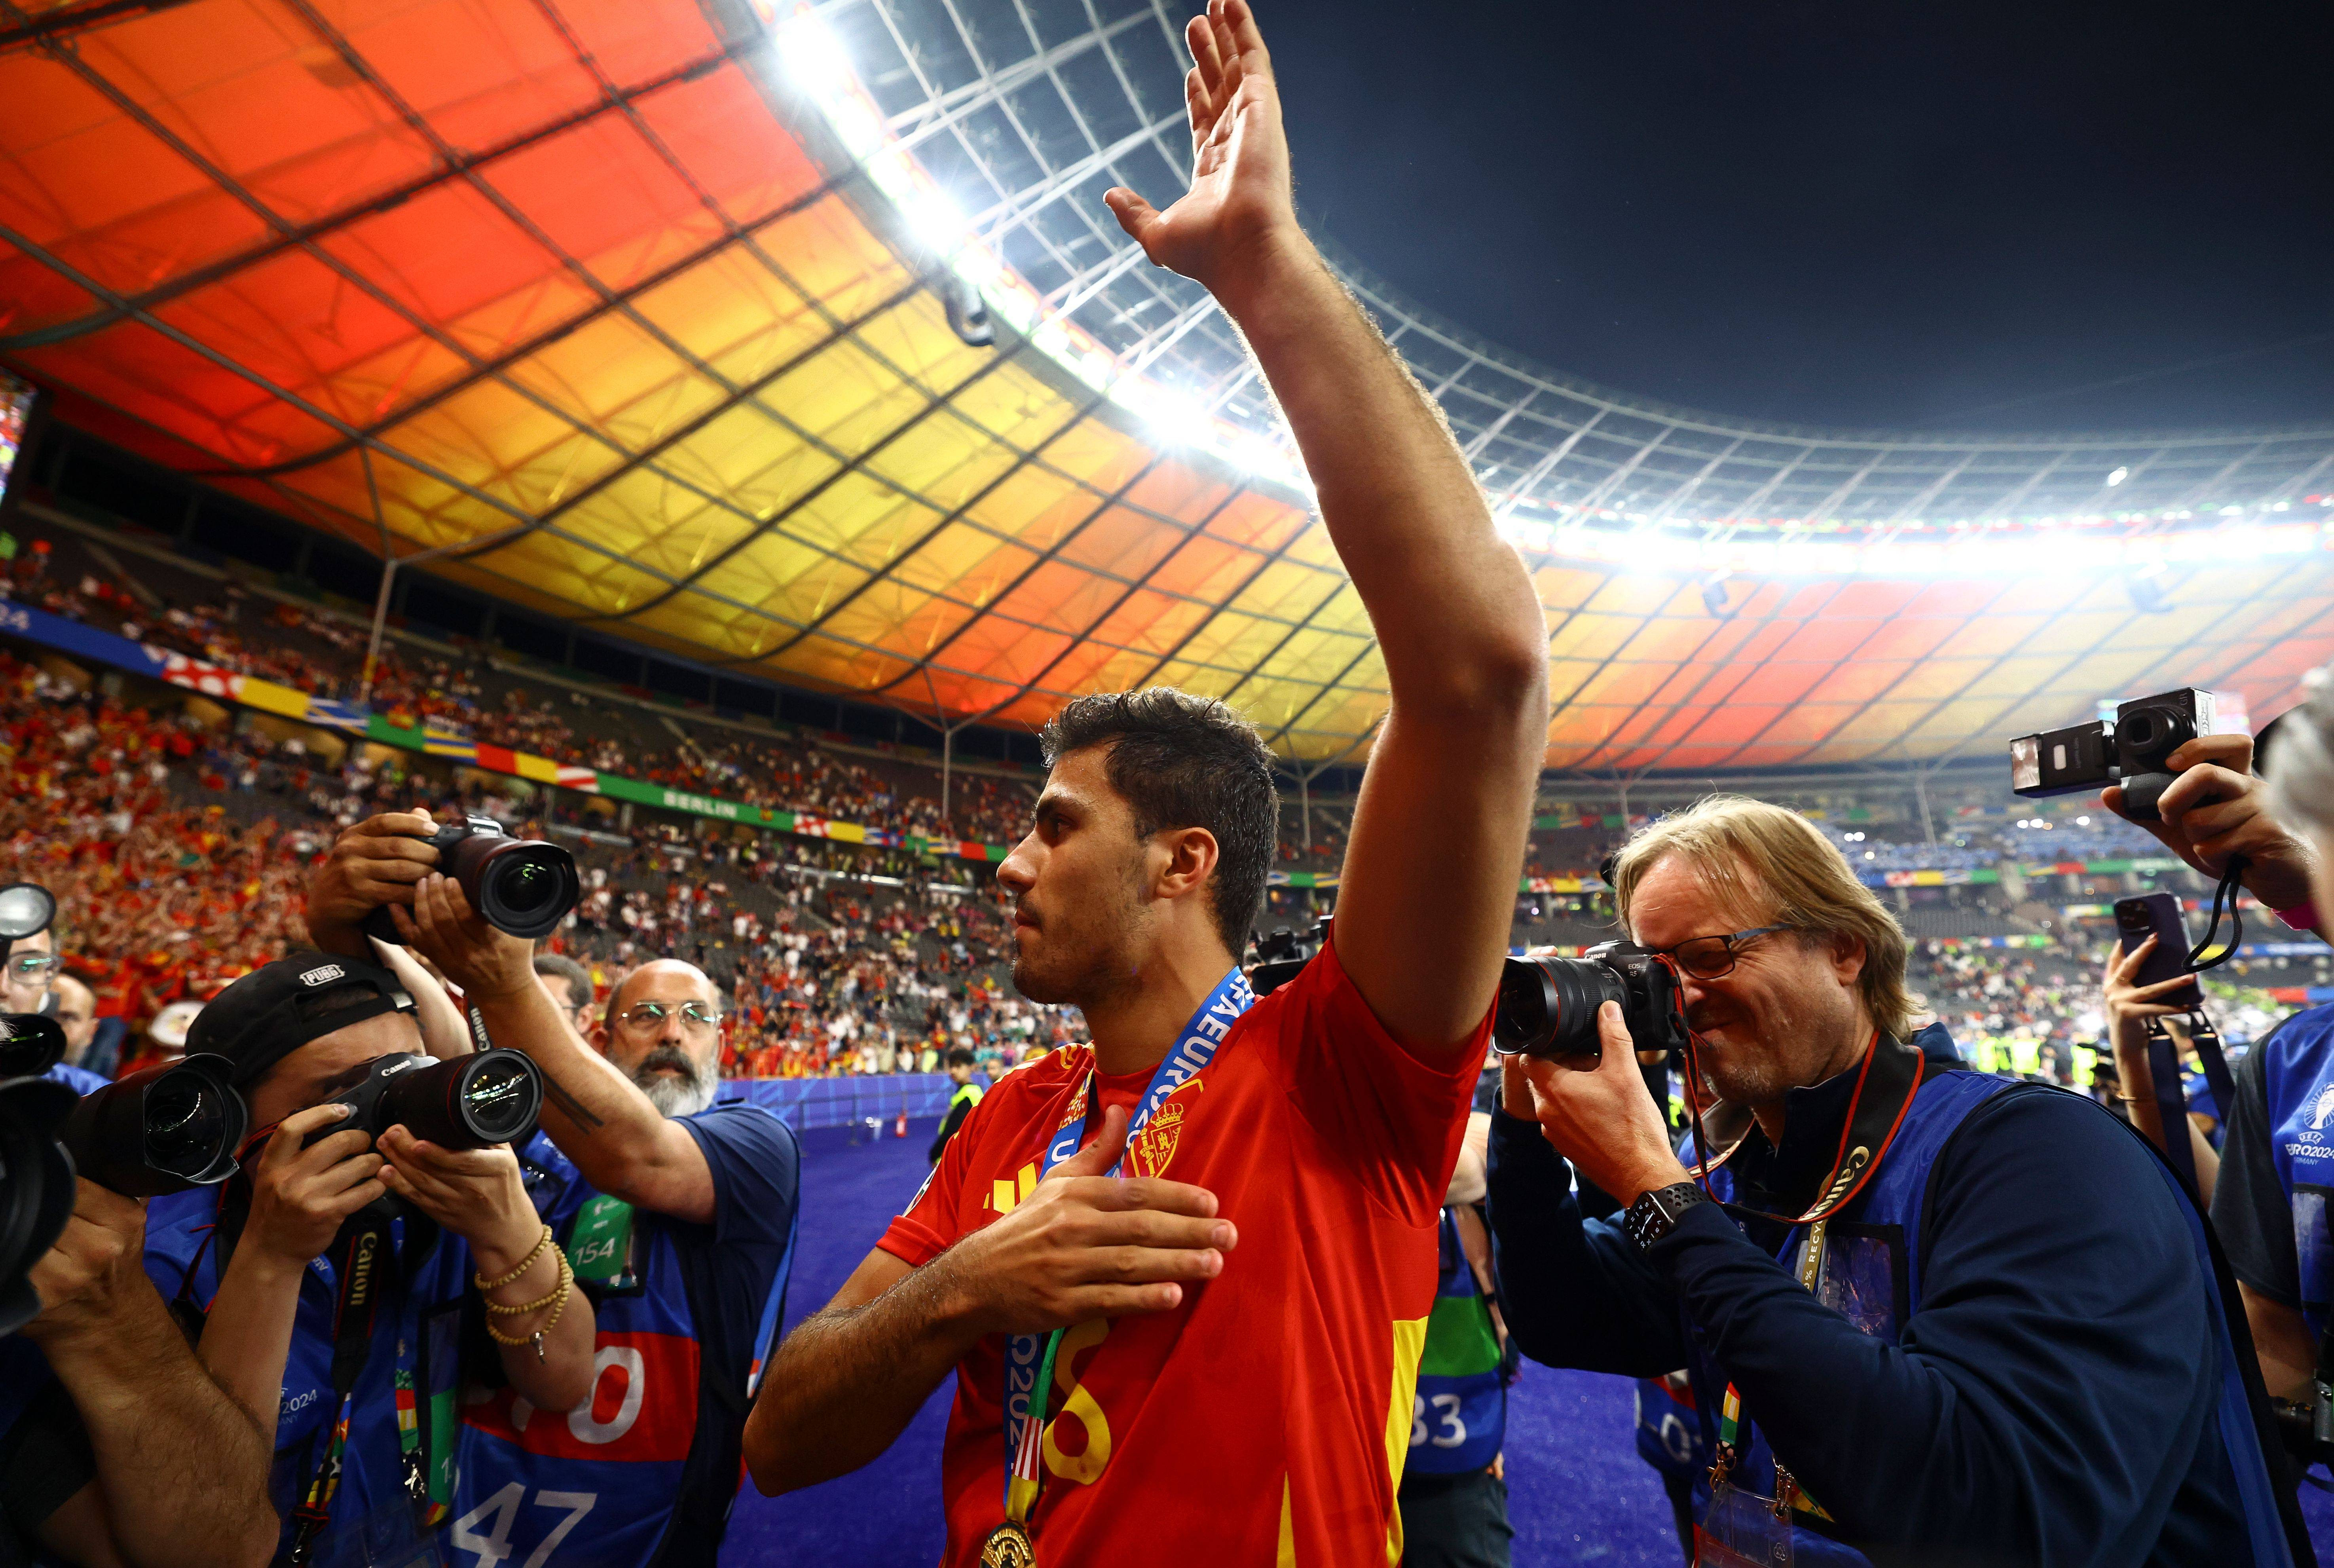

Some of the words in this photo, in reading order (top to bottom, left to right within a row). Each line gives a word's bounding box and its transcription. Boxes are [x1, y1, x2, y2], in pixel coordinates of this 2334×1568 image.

[664, 791, 737, 819] BERLIN
[304, 966, 341, 984] PUBG
[470, 1007, 491, 1052] Canon
[381, 1059, 412, 1076] Canon
[1798, 1146, 1869, 1221] Canon
[350, 1231, 378, 1305] Canon
[575, 1237, 616, 1266] 154
[450, 1470, 598, 1568] 47
